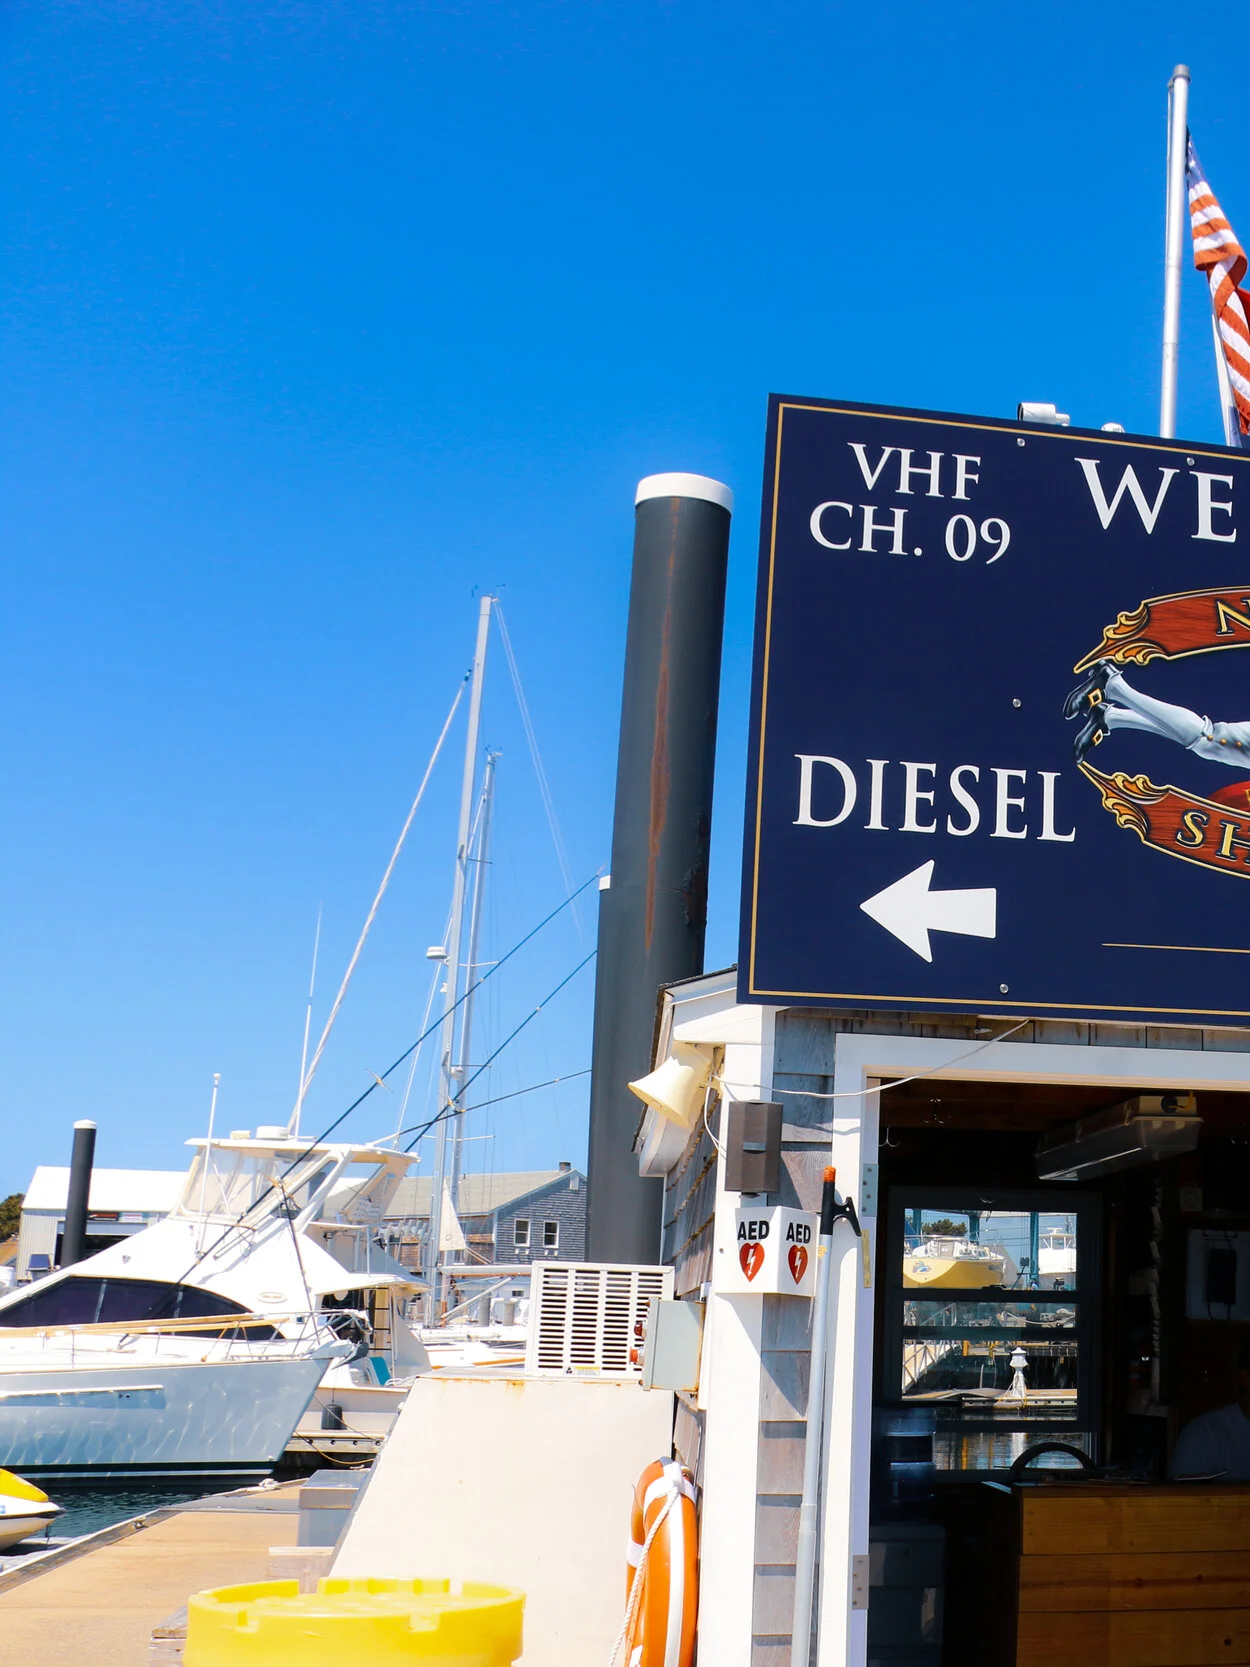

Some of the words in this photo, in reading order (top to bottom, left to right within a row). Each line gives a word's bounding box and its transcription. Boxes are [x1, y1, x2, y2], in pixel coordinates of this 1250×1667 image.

[848, 442, 981, 501] VHF
[809, 501, 923, 557] CH.
[945, 514, 1011, 565] 09
[792, 753, 1076, 843] DIESEL
[737, 1220, 770, 1241] AED
[786, 1222, 812, 1244] AED
